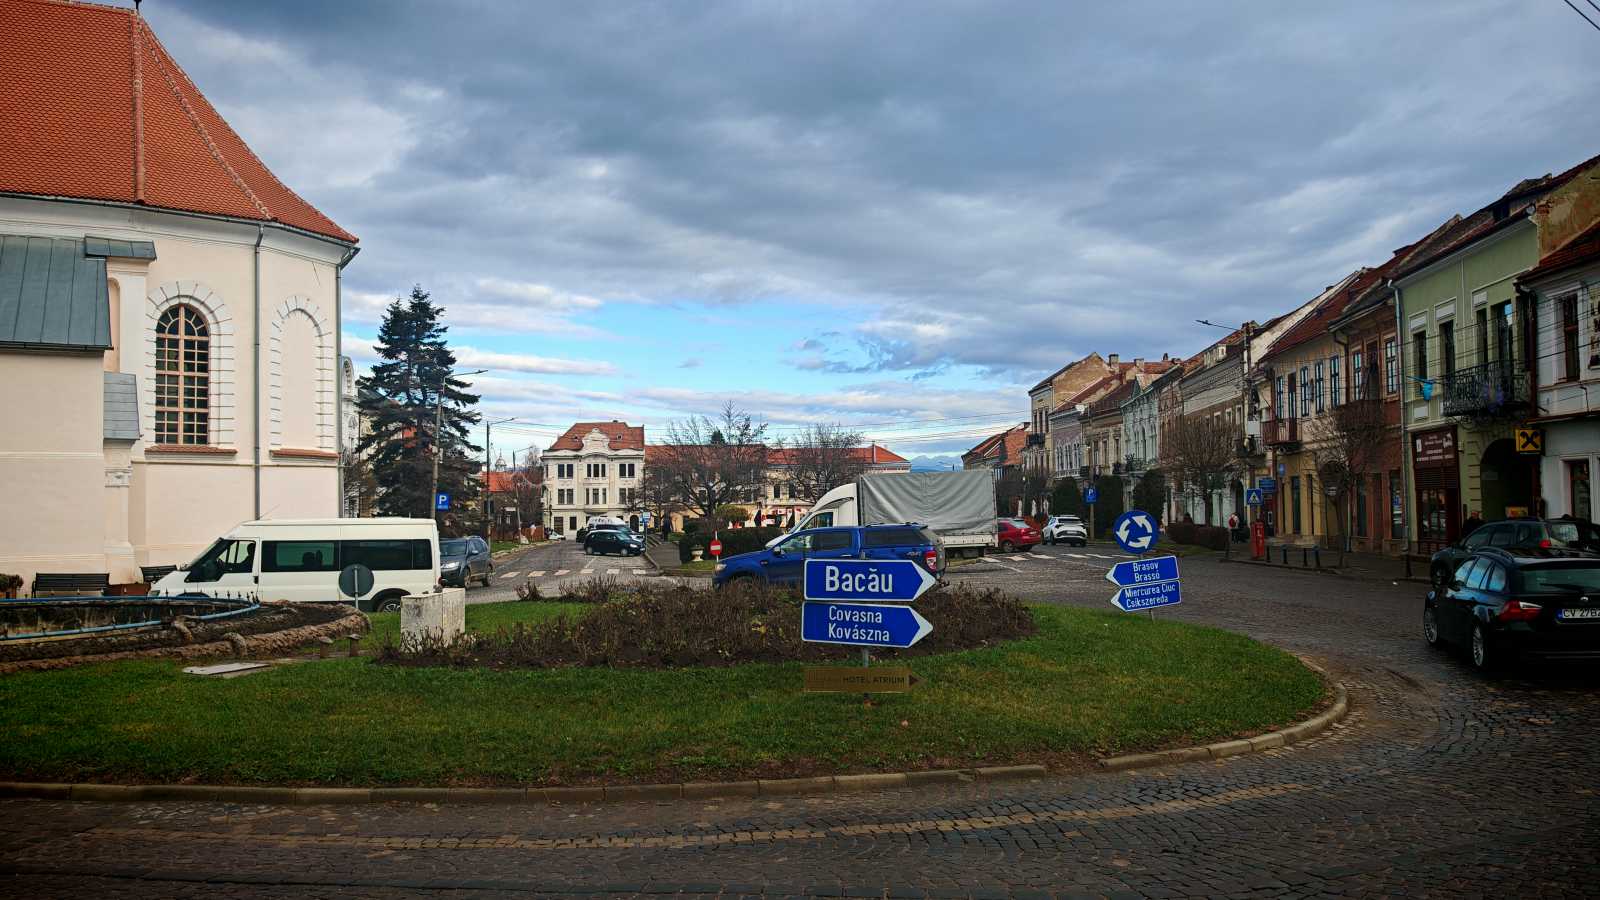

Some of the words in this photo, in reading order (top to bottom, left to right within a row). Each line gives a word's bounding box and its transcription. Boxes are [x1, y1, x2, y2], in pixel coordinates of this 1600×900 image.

[439, 495, 447, 505] P
[825, 566, 893, 593] Bacău
[1125, 586, 1161, 598] Miercurea
[1161, 584, 1176, 592] Ciuc
[829, 605, 883, 623] Covasna
[1563, 609, 1576, 617] CV
[828, 623, 890, 641] Kovászna
[872, 676, 905, 684] ATRIUM
